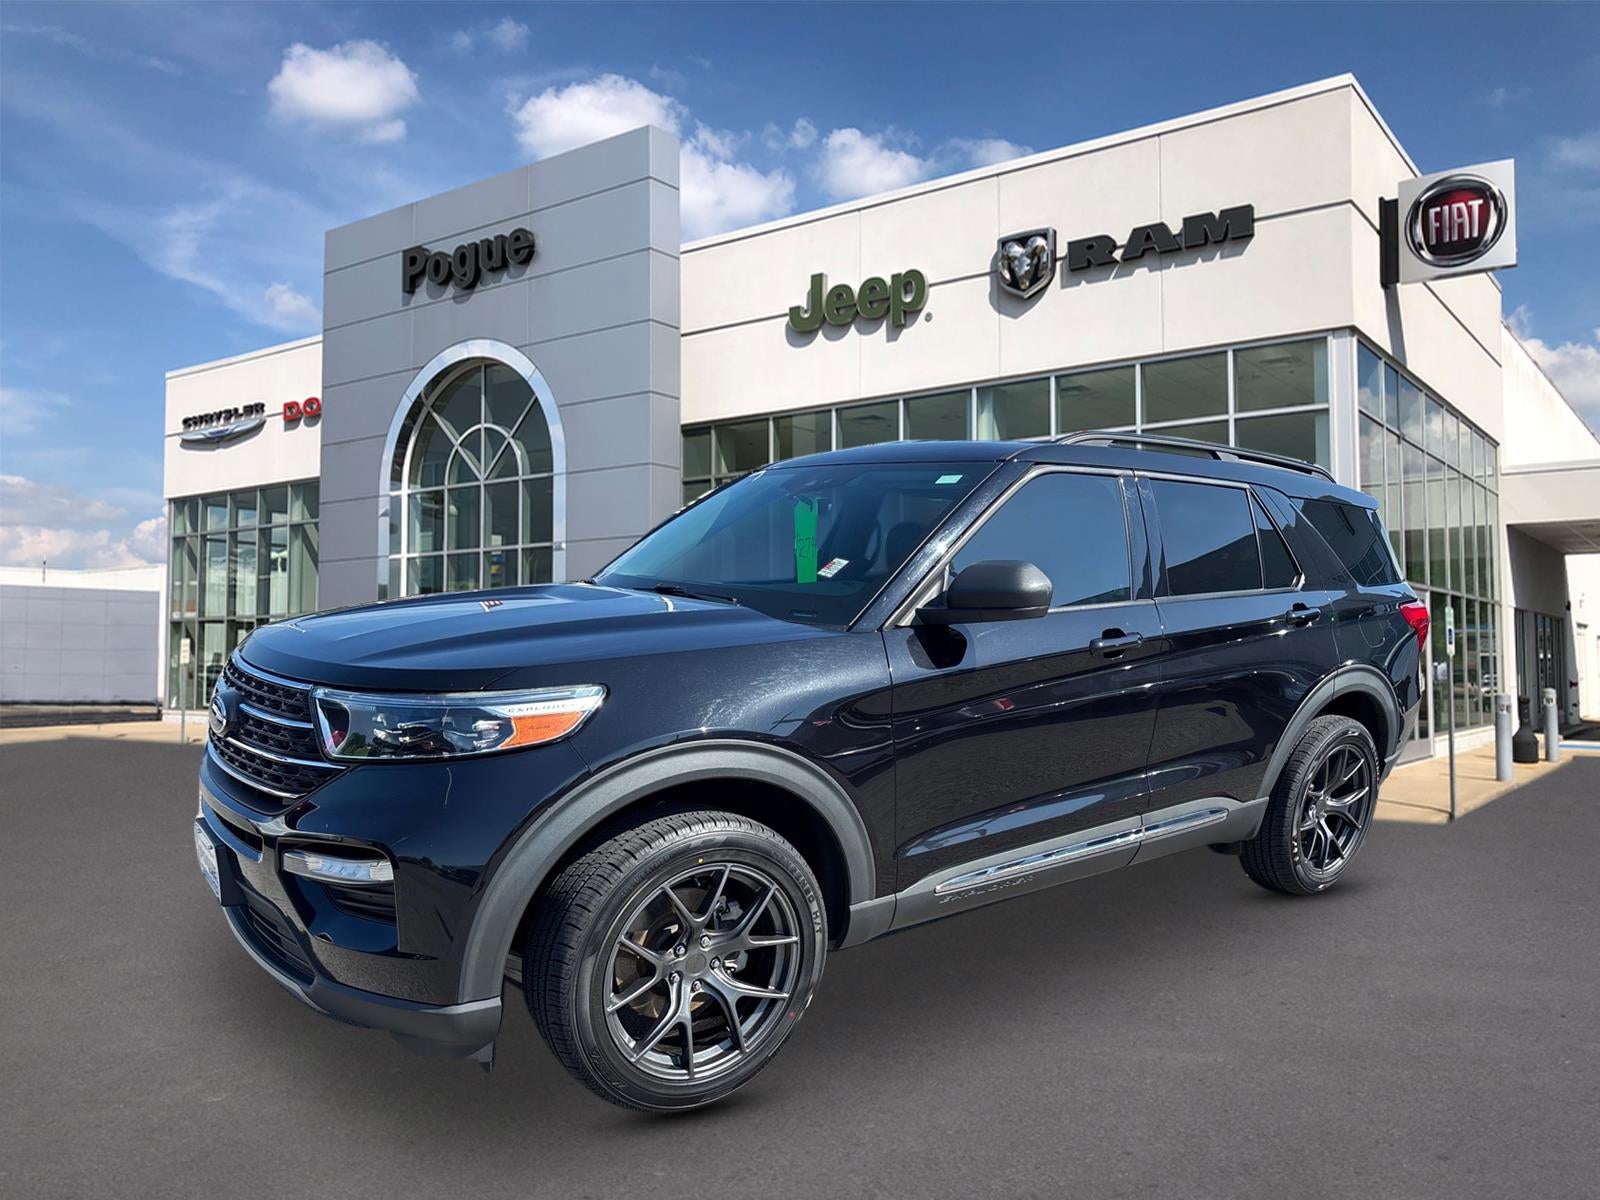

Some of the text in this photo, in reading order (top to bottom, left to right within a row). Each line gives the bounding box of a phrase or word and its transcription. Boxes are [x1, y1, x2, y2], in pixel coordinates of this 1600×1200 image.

[1067, 203, 1255, 272] RAM
[1428, 199, 1484, 246] FIAT
[402, 227, 536, 295] Pogue
[788, 268, 928, 333] Jeep
[182, 402, 265, 428] CHRYSLER
